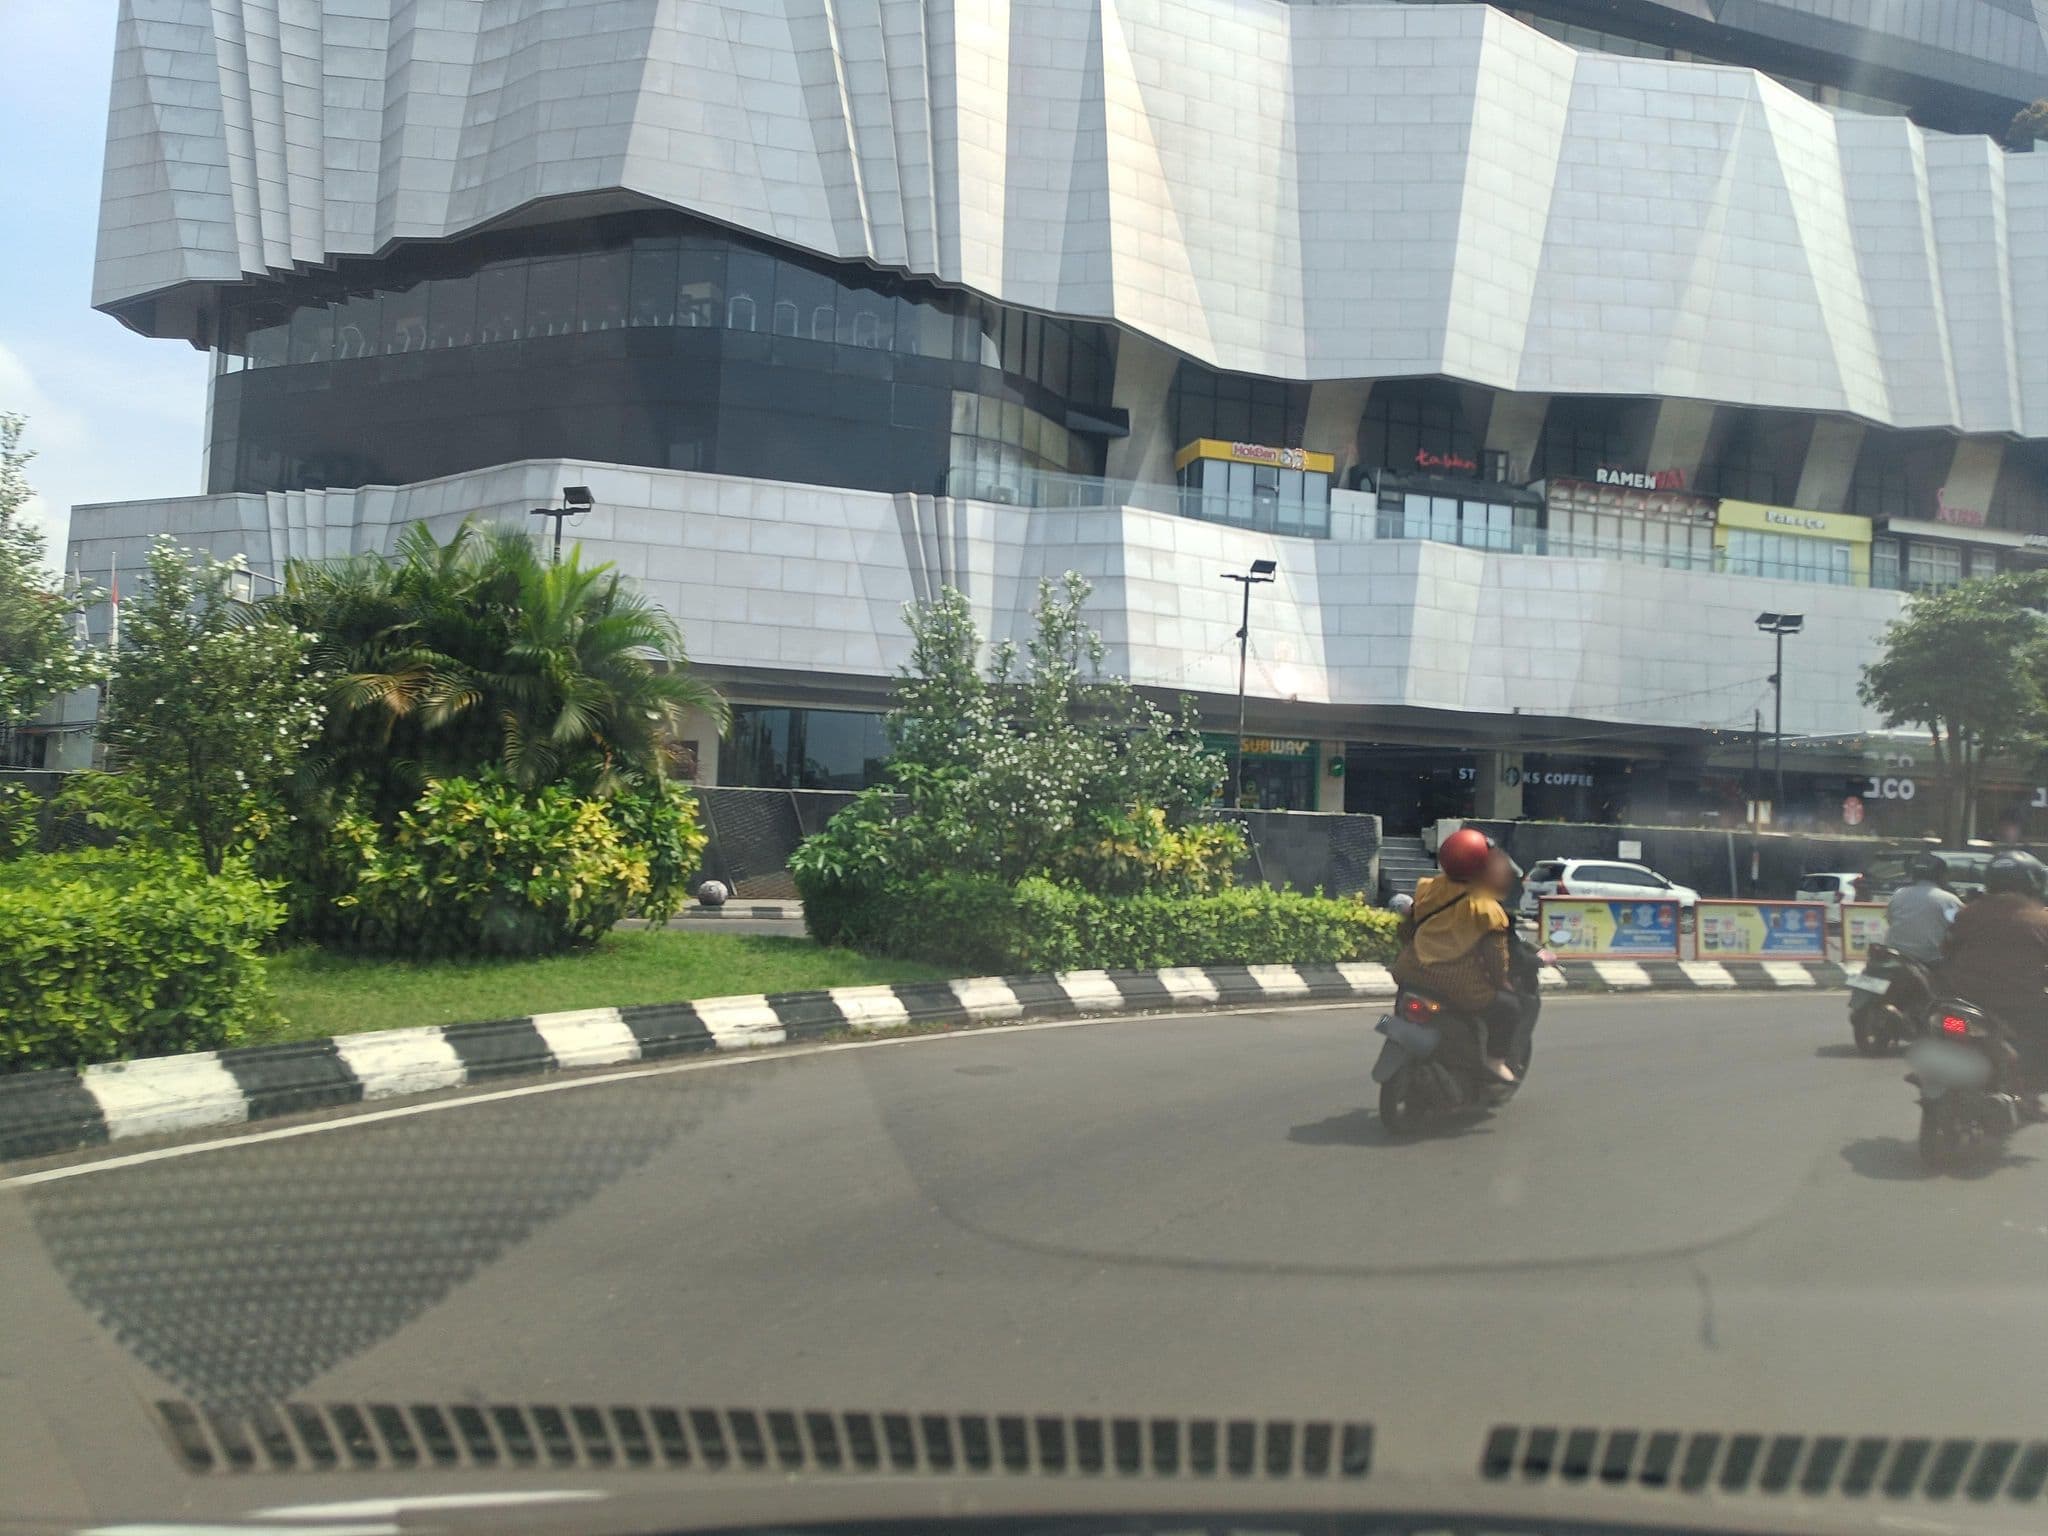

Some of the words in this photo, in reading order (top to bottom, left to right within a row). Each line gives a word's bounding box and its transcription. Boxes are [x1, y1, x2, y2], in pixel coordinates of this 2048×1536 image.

[1596, 468, 1657, 490] RAMEN
[1241, 738, 1310, 755] SUBWAY
[1544, 773, 1594, 786] COFFEE
